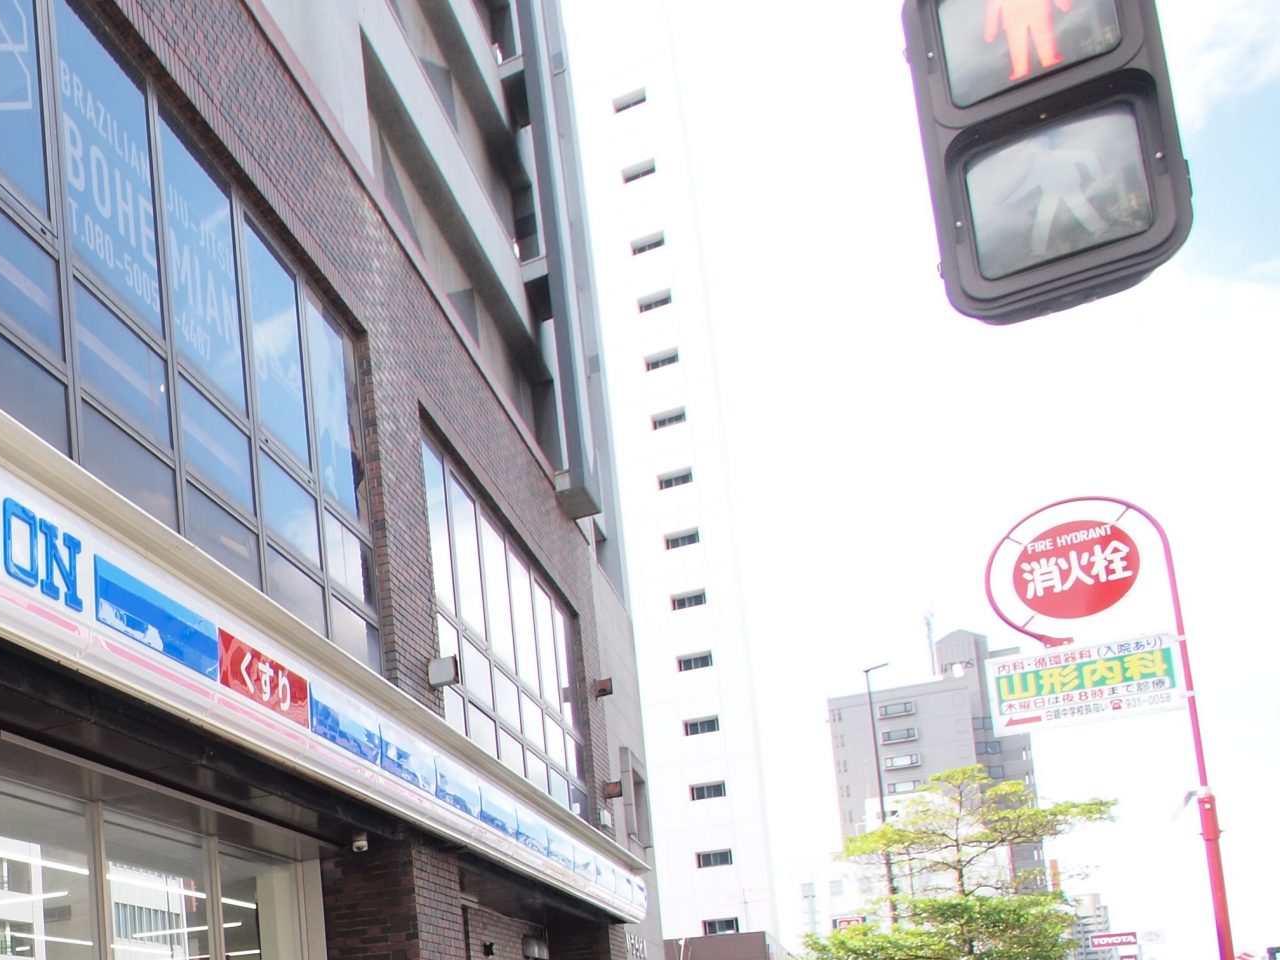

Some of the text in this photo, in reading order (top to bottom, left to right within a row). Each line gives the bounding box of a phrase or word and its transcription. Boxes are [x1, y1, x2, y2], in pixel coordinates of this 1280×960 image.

[60, 58, 151, 188] BRAZILIAN
[1026, 524, 1113, 555] FIRE HYDRANT
[1020, 539, 1133, 600] 消火栓
[240, 651, 291, 711] くすり
[999, 649, 1168, 701] 山形内科
[1091, 933, 1136, 946] TOYOTA
